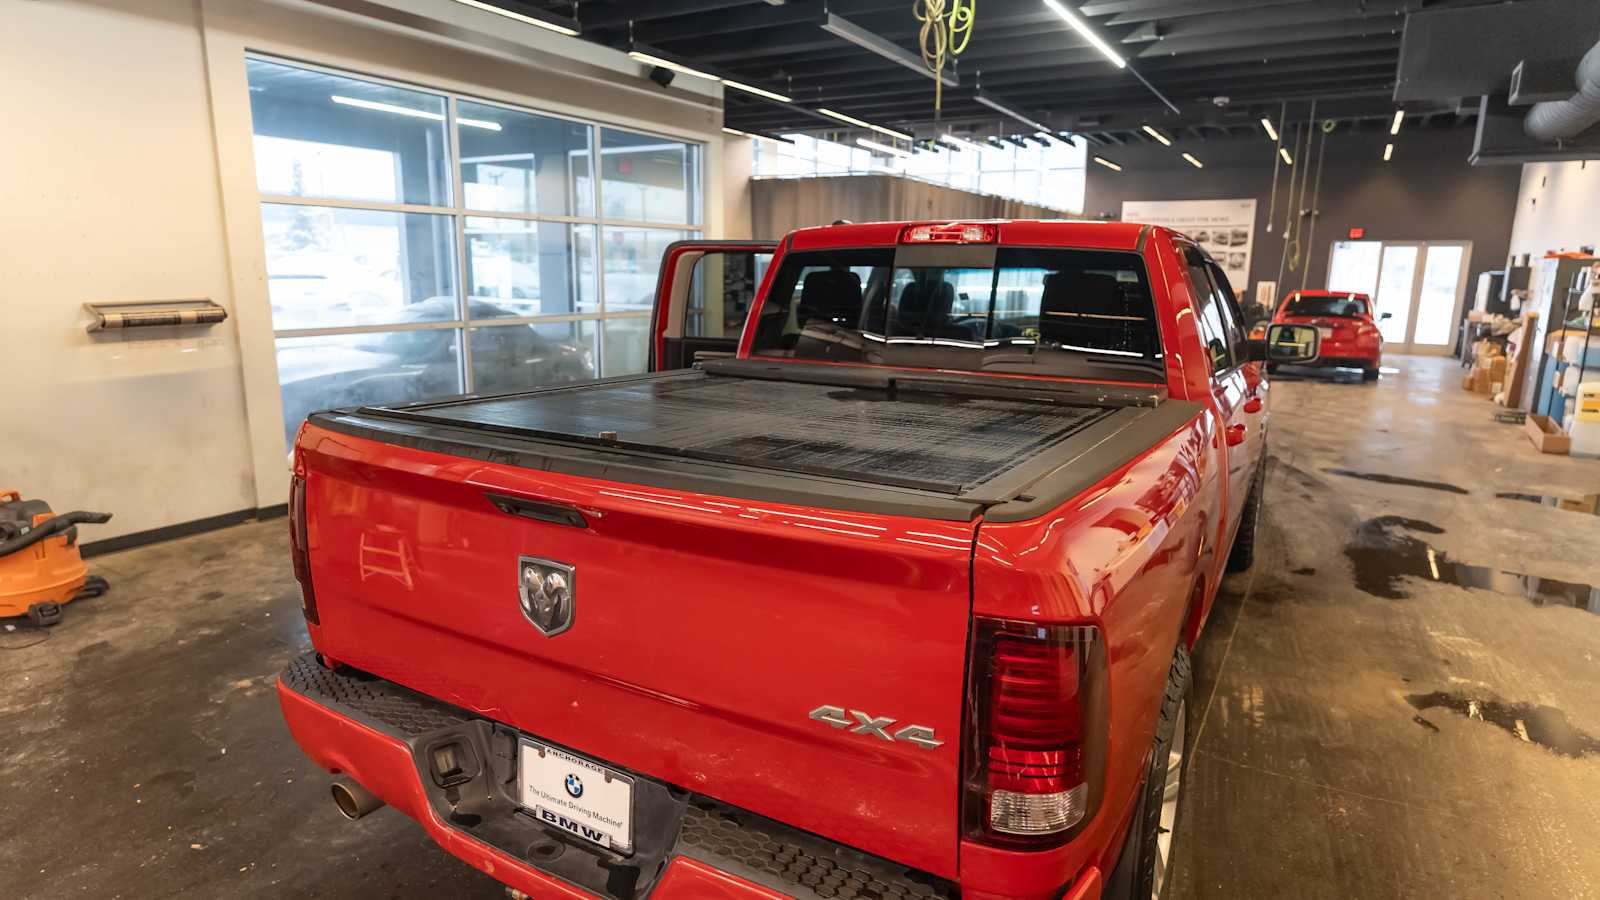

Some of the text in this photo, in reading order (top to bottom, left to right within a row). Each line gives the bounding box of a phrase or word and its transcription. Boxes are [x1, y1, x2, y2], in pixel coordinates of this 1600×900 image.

[546, 749, 604, 774] ANCHORAGE
[529, 784, 540, 796] The
[540, 790, 568, 807] Ultimate
[568, 801, 591, 817] Driving
[542, 809, 603, 842] BMW
